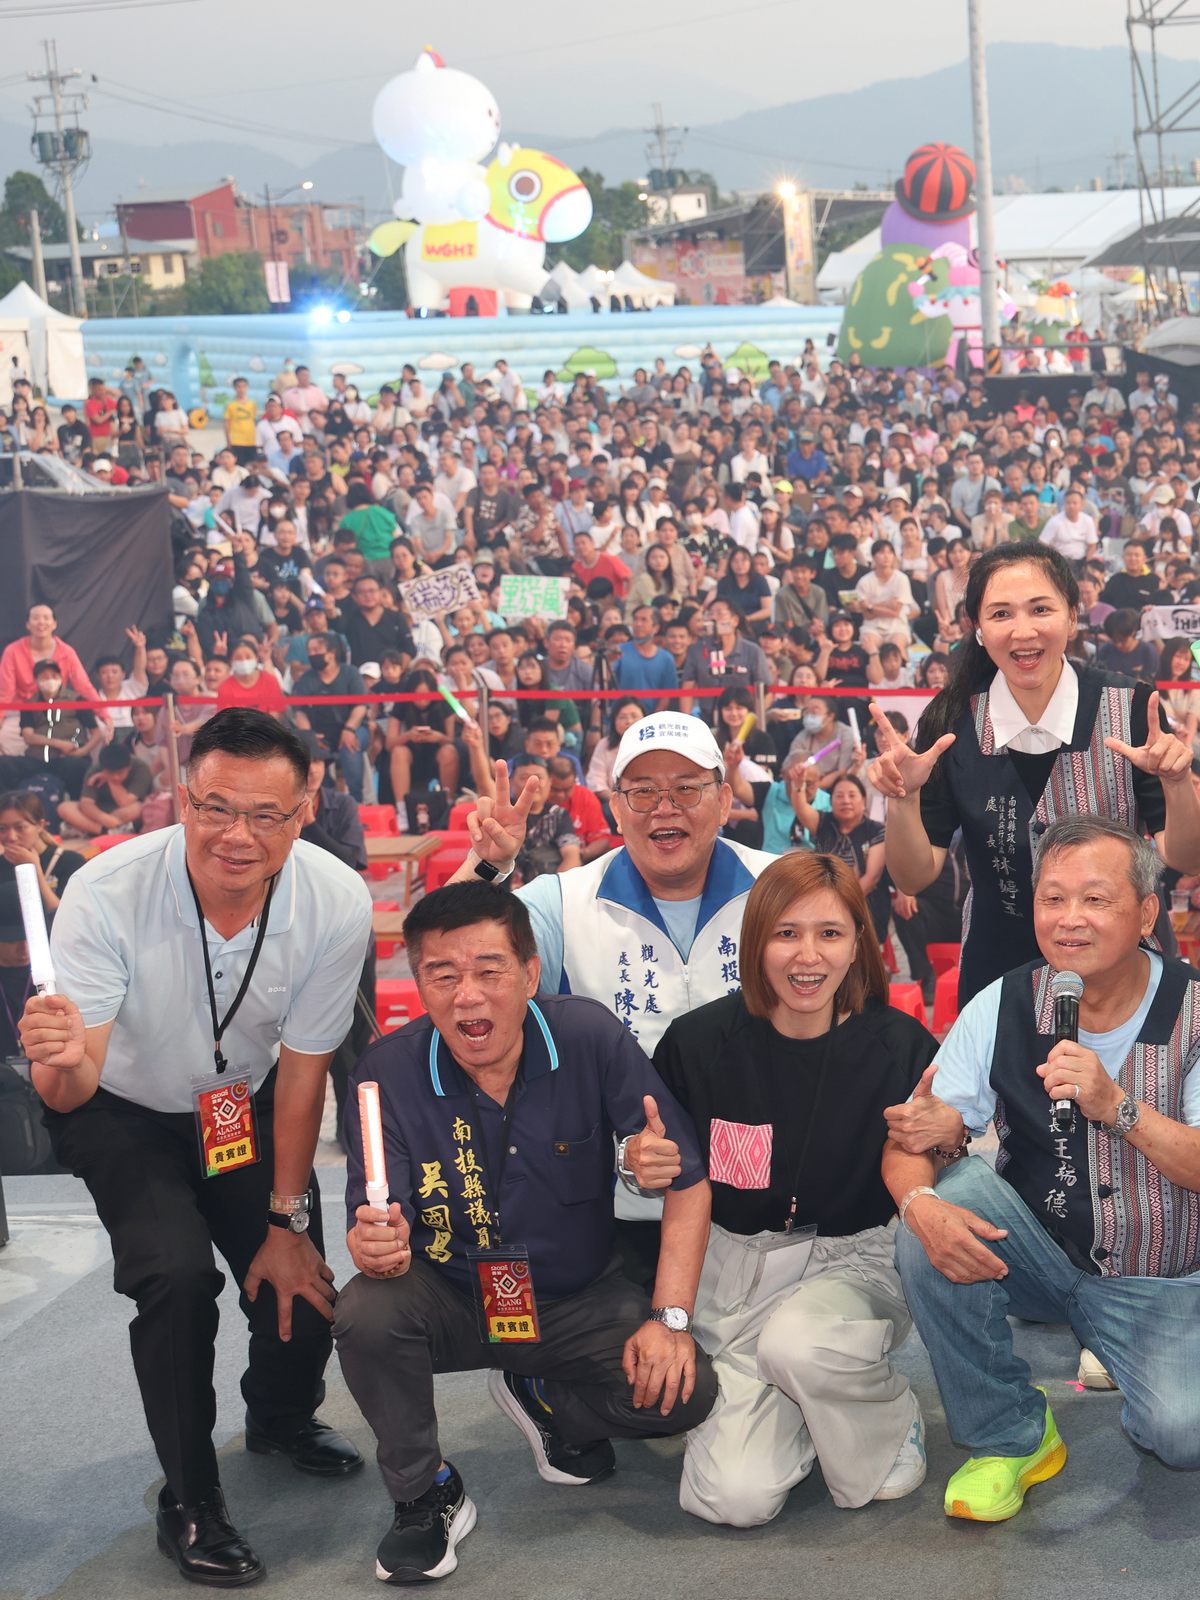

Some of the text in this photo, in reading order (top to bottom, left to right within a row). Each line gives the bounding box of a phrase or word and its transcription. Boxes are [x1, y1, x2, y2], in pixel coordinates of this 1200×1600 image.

[640, 943, 662, 1014] 觀光處
[452, 1117, 493, 1250] 南投縣議員
